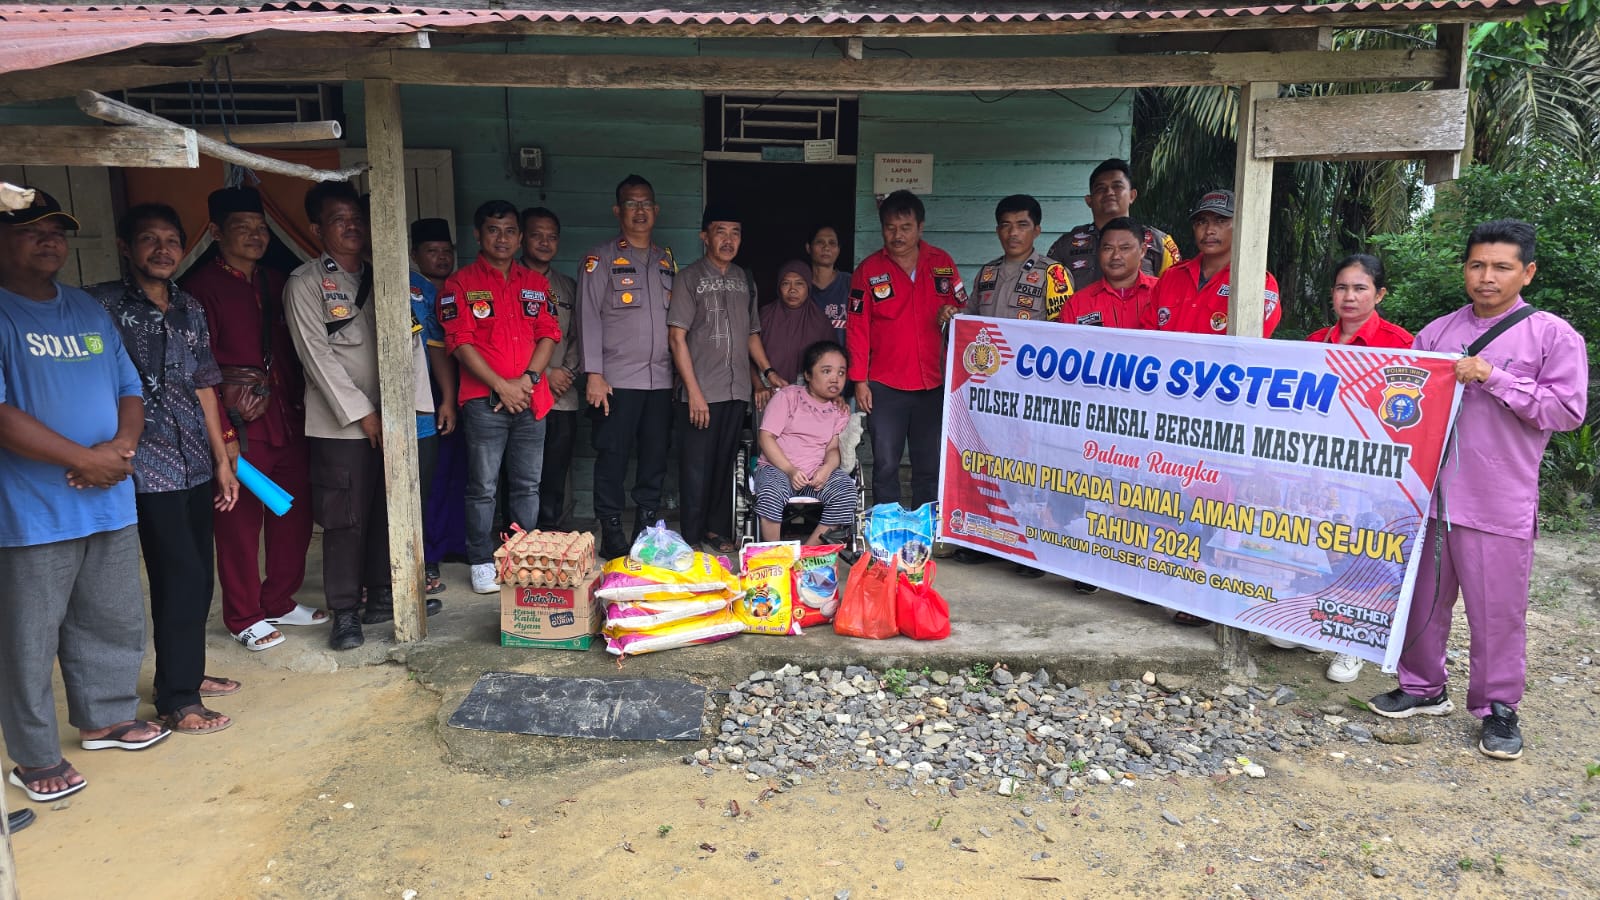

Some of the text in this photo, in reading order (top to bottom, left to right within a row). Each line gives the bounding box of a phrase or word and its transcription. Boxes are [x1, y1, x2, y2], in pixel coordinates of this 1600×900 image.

[1017, 284, 1041, 296] POLRI
[26, 333, 88, 358] SOUL
[1016, 344, 1162, 393] COOLING
[1166, 359, 1340, 414] SYSTEM
[969, 387, 1411, 479] POLSEK BATANG GANSAL BERSAMA MASYARAKAT
[1083, 440, 1220, 488] Dalam Rangka
[961, 450, 1036, 486] CIPTAKAN
[1041, 467, 1114, 504] PILKADA
[1119, 483, 1185, 525] DAMAI,
[1190, 498, 1254, 534] AMAN
[1261, 509, 1311, 546] DAN
[1316, 521, 1407, 564] SEJUK
[1086, 511, 1201, 562] TAHUN 2024
[1025, 526, 1278, 603] DI WILKUM POLSEK BATANG GANSAL
[1317, 599, 1390, 628] TOGETHER
